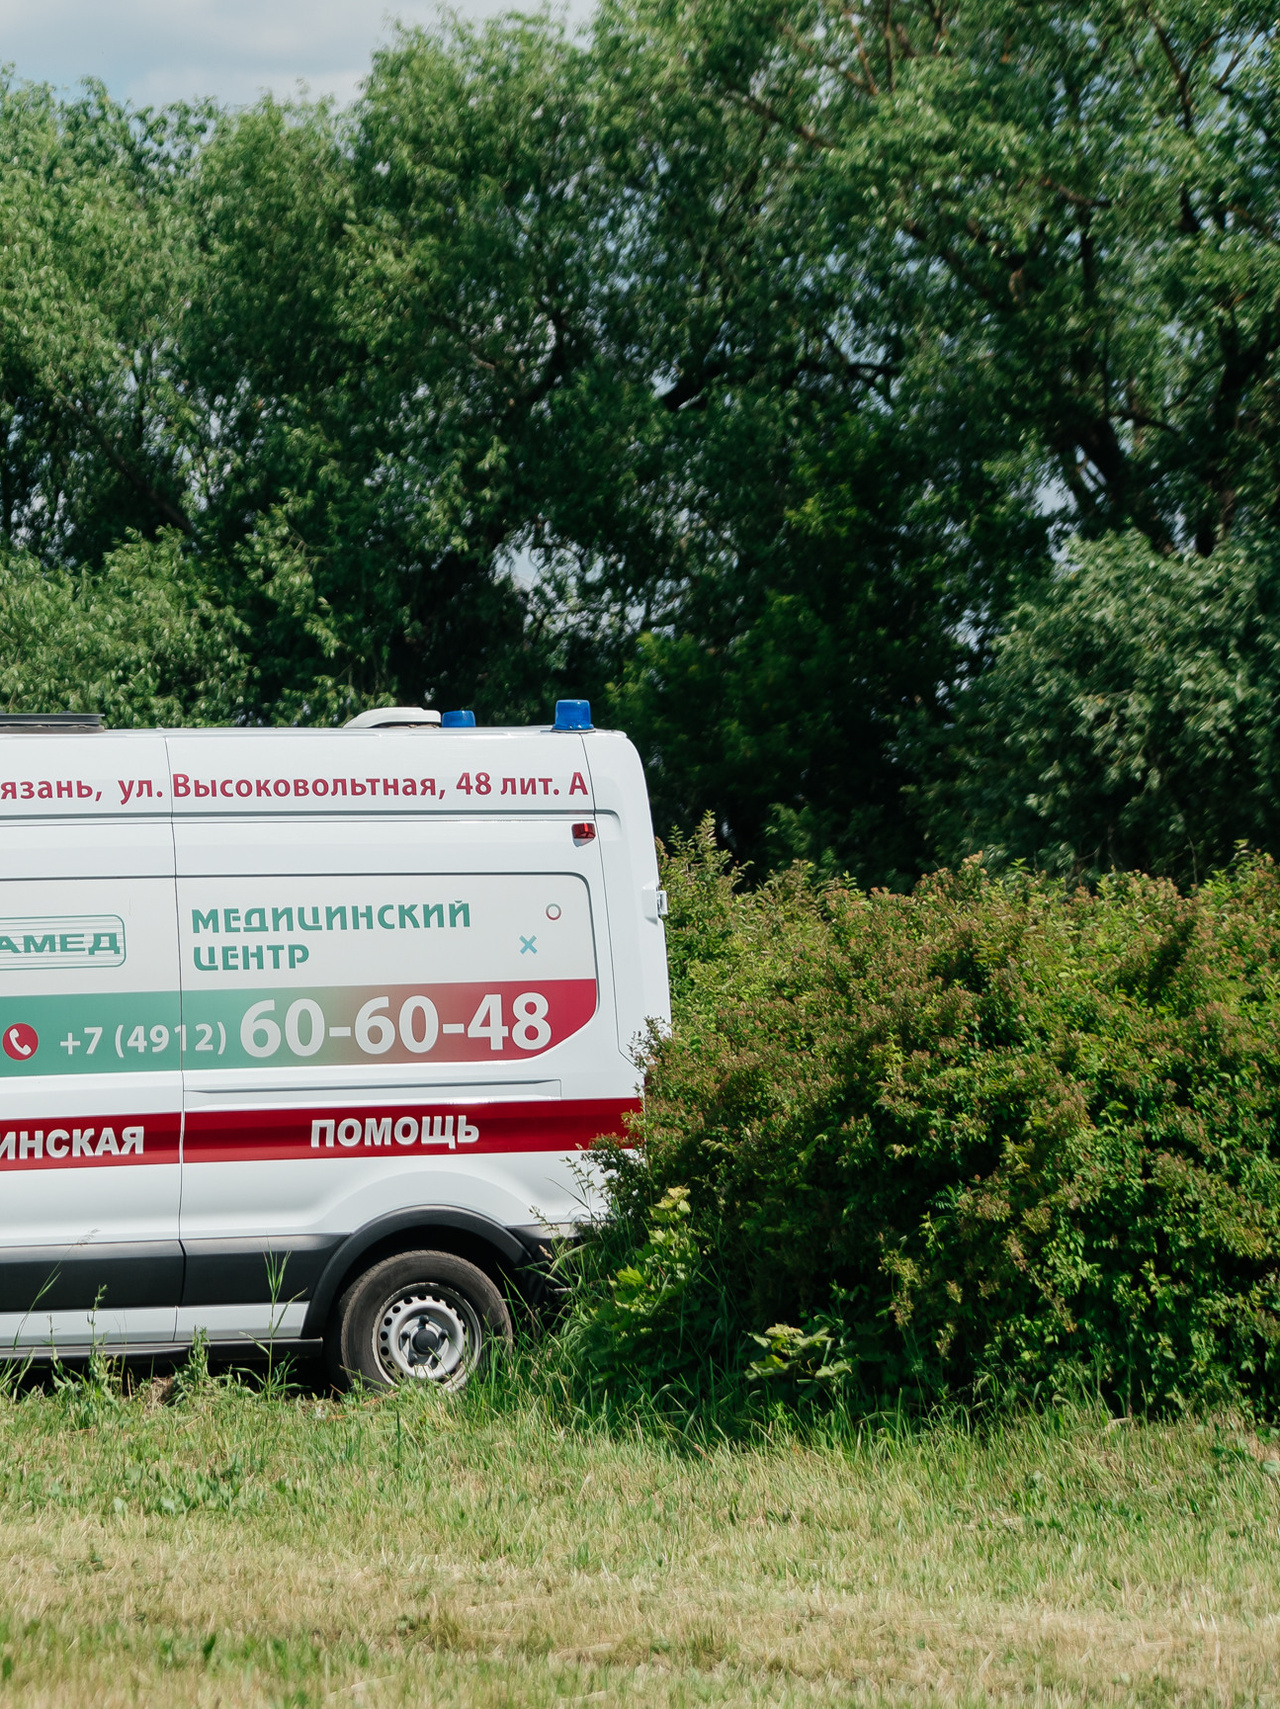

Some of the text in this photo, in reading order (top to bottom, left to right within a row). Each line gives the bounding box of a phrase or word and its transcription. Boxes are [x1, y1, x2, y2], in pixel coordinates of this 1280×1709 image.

[117, 779, 164, 805] ул.
[172, 773, 447, 800] Высоковольтная,
[455, 772, 492, 796] 48
[500, 776, 560, 796] лит.
[568, 771, 589, 796] А
[191, 899, 471, 934] МЕДИЦИНСКИЙ
[192, 944, 310, 971] ЦЕНТР
[59, 991, 553, 1059] +7 (4912) 60-60-48
[310, 1114, 481, 1149] ПОМОЩЬ
